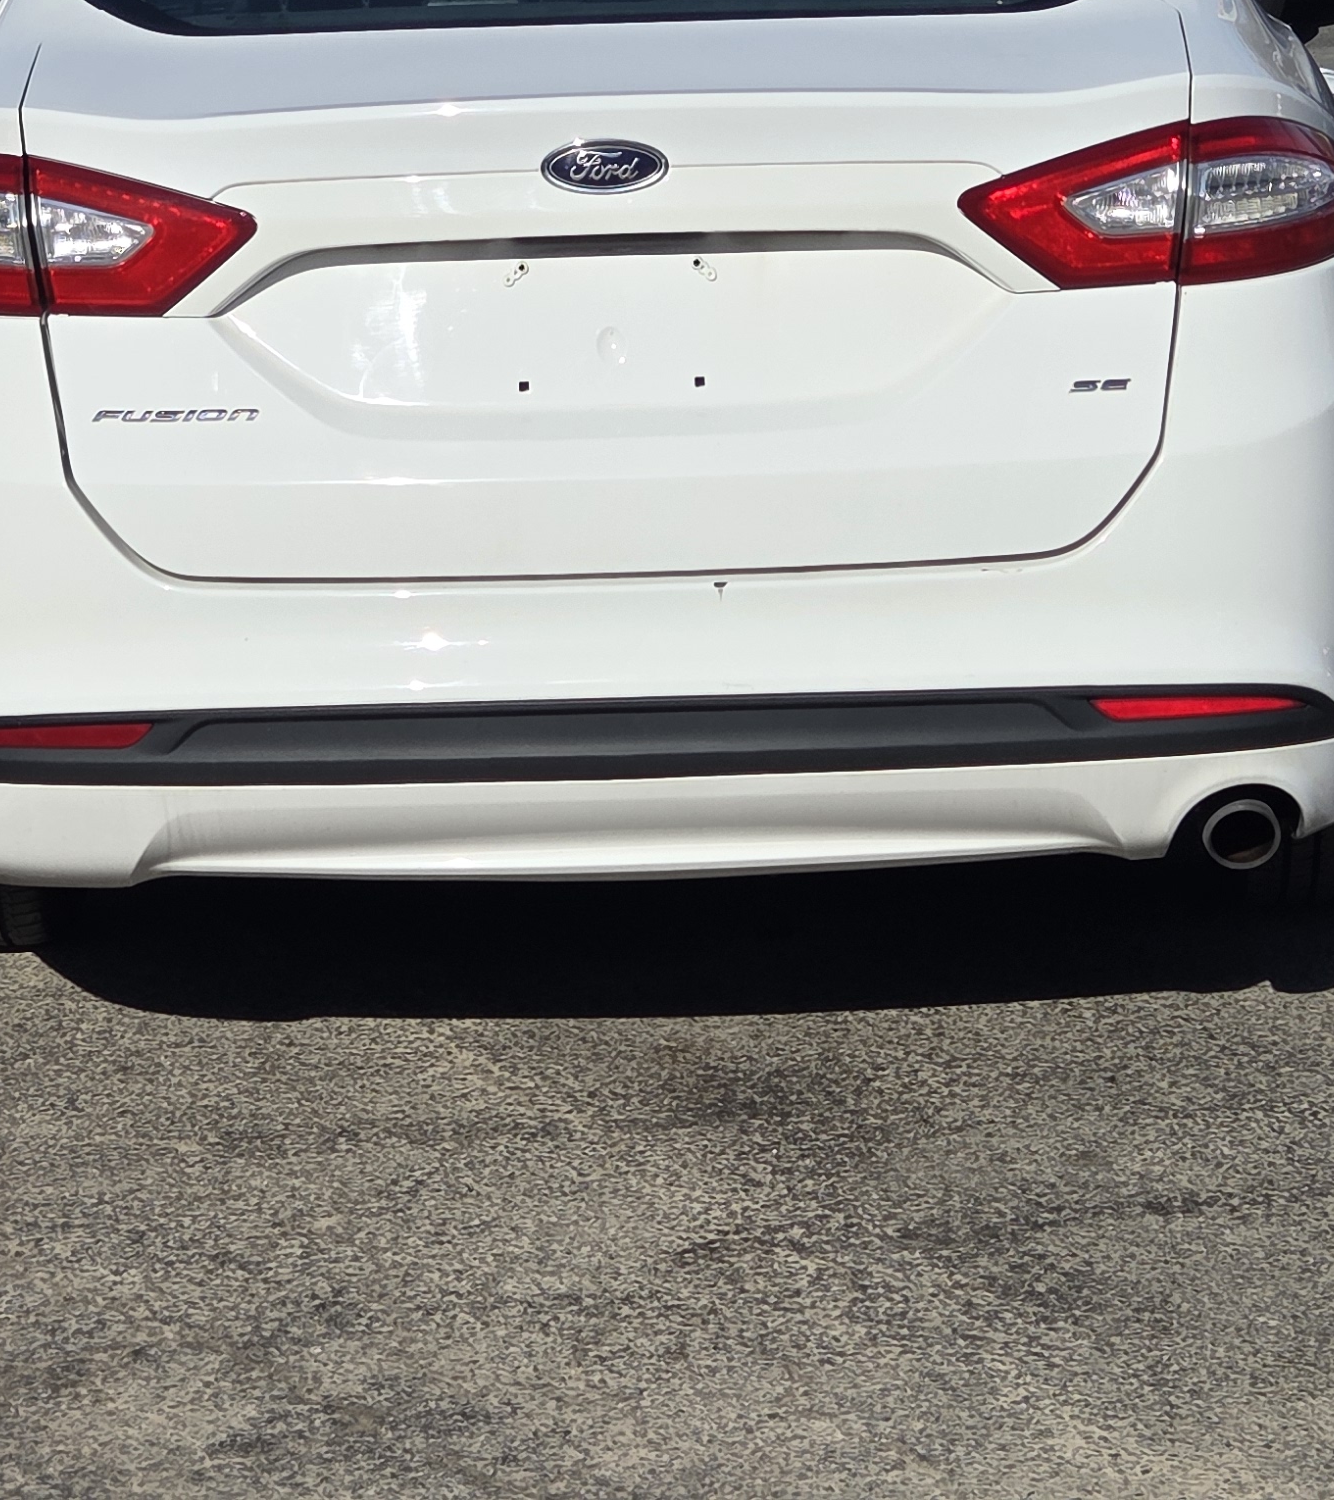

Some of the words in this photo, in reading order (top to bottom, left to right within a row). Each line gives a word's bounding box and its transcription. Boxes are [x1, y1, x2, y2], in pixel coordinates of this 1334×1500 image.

[570, 149, 640, 181] Ford
[1069, 378, 1131, 393] SE
[92, 408, 260, 423] FUSION
